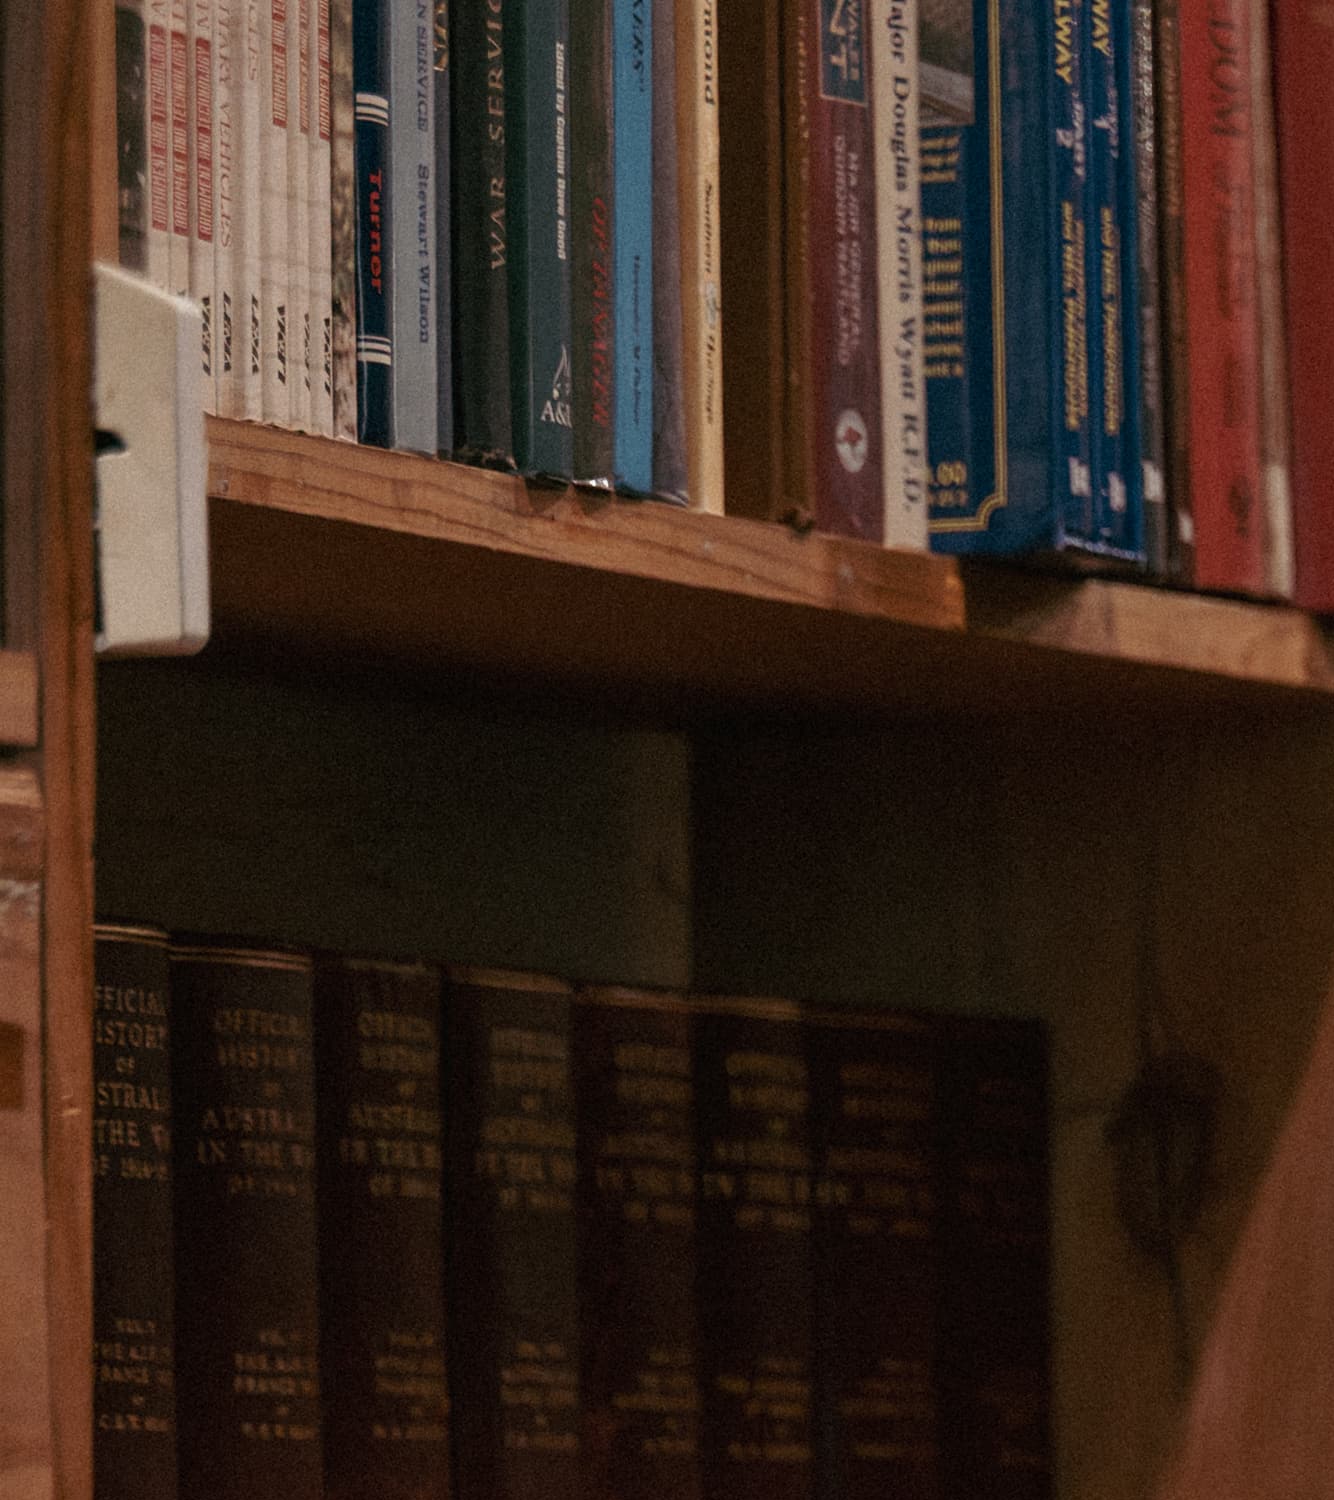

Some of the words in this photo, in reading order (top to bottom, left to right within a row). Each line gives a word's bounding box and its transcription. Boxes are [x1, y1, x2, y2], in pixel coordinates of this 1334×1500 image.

[273, 48, 287, 121] ARMAMENT
[415, 26, 431, 133] SERVICE
[554, 42, 565, 88] Edited
[217, 103, 231, 247] VEHICLES
[554, 116, 566, 174] Captain
[891, 76, 912, 192] Douglas
[173, 158, 188, 228] ARMAMENT
[198, 163, 211, 235] ARMAMENT
[416, 163, 432, 258] Stewart
[488, 177, 506, 270] WAR
[556, 178, 566, 215] Dave
[834, 135, 847, 235] GORDON
[847, 152, 860, 233] MAJOR
[367, 168, 384, 295] Turner
[896, 206, 915, 302] Morris
[418, 265, 433, 345] Wilson
[849, 240, 861, 347] GENERAL
[898, 317, 918, 401] Wyatt
